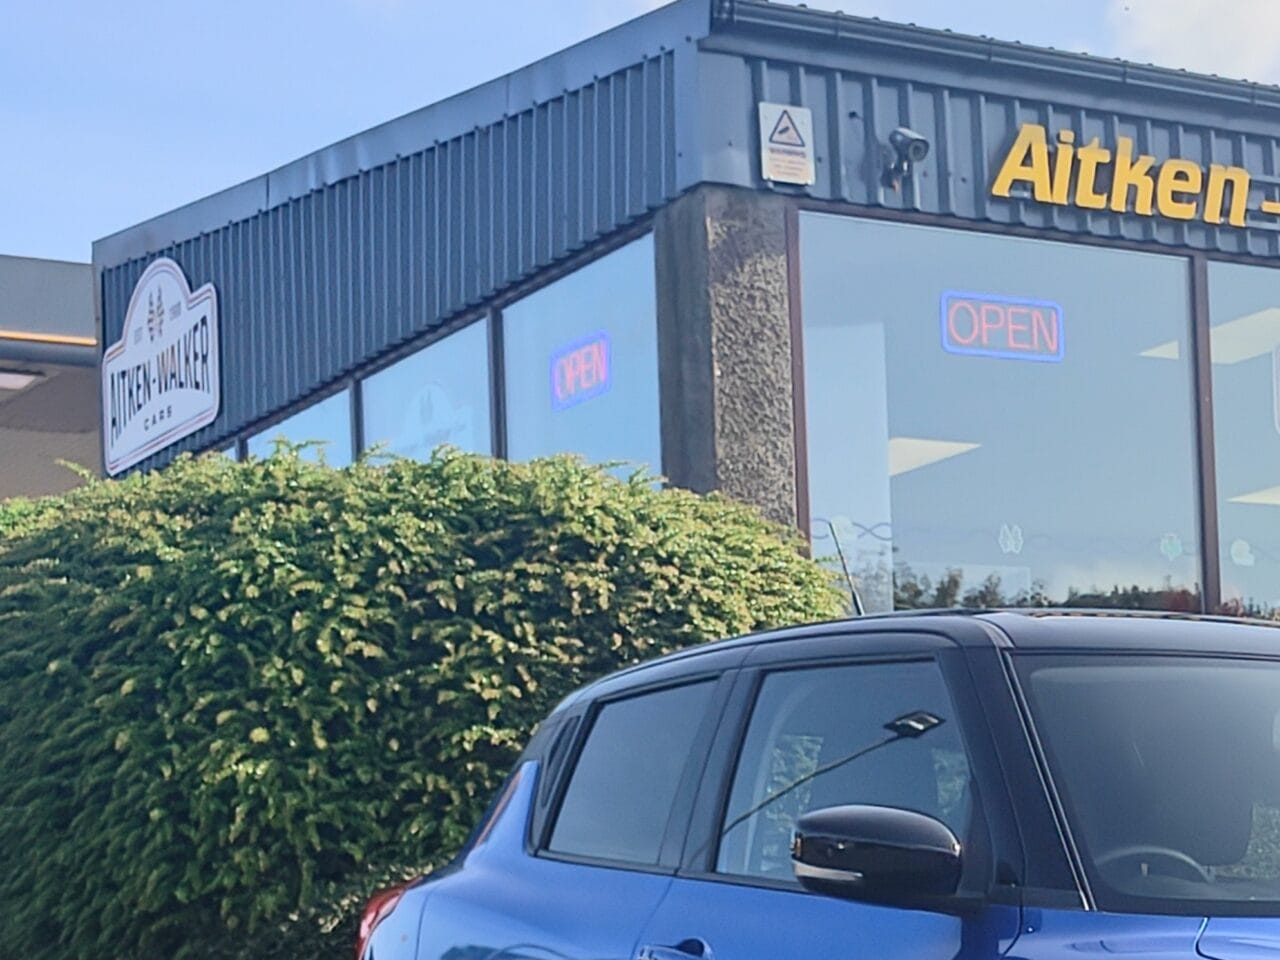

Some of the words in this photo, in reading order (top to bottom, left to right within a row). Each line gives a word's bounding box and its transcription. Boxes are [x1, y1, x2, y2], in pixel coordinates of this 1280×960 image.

[991, 123, 1251, 227] Aitken
[948, 301, 1058, 353] OPEN
[109, 315, 211, 449] AITKEN-WALKER
[554, 342, 607, 401] OPEN
[144, 405, 173, 431] CARS
